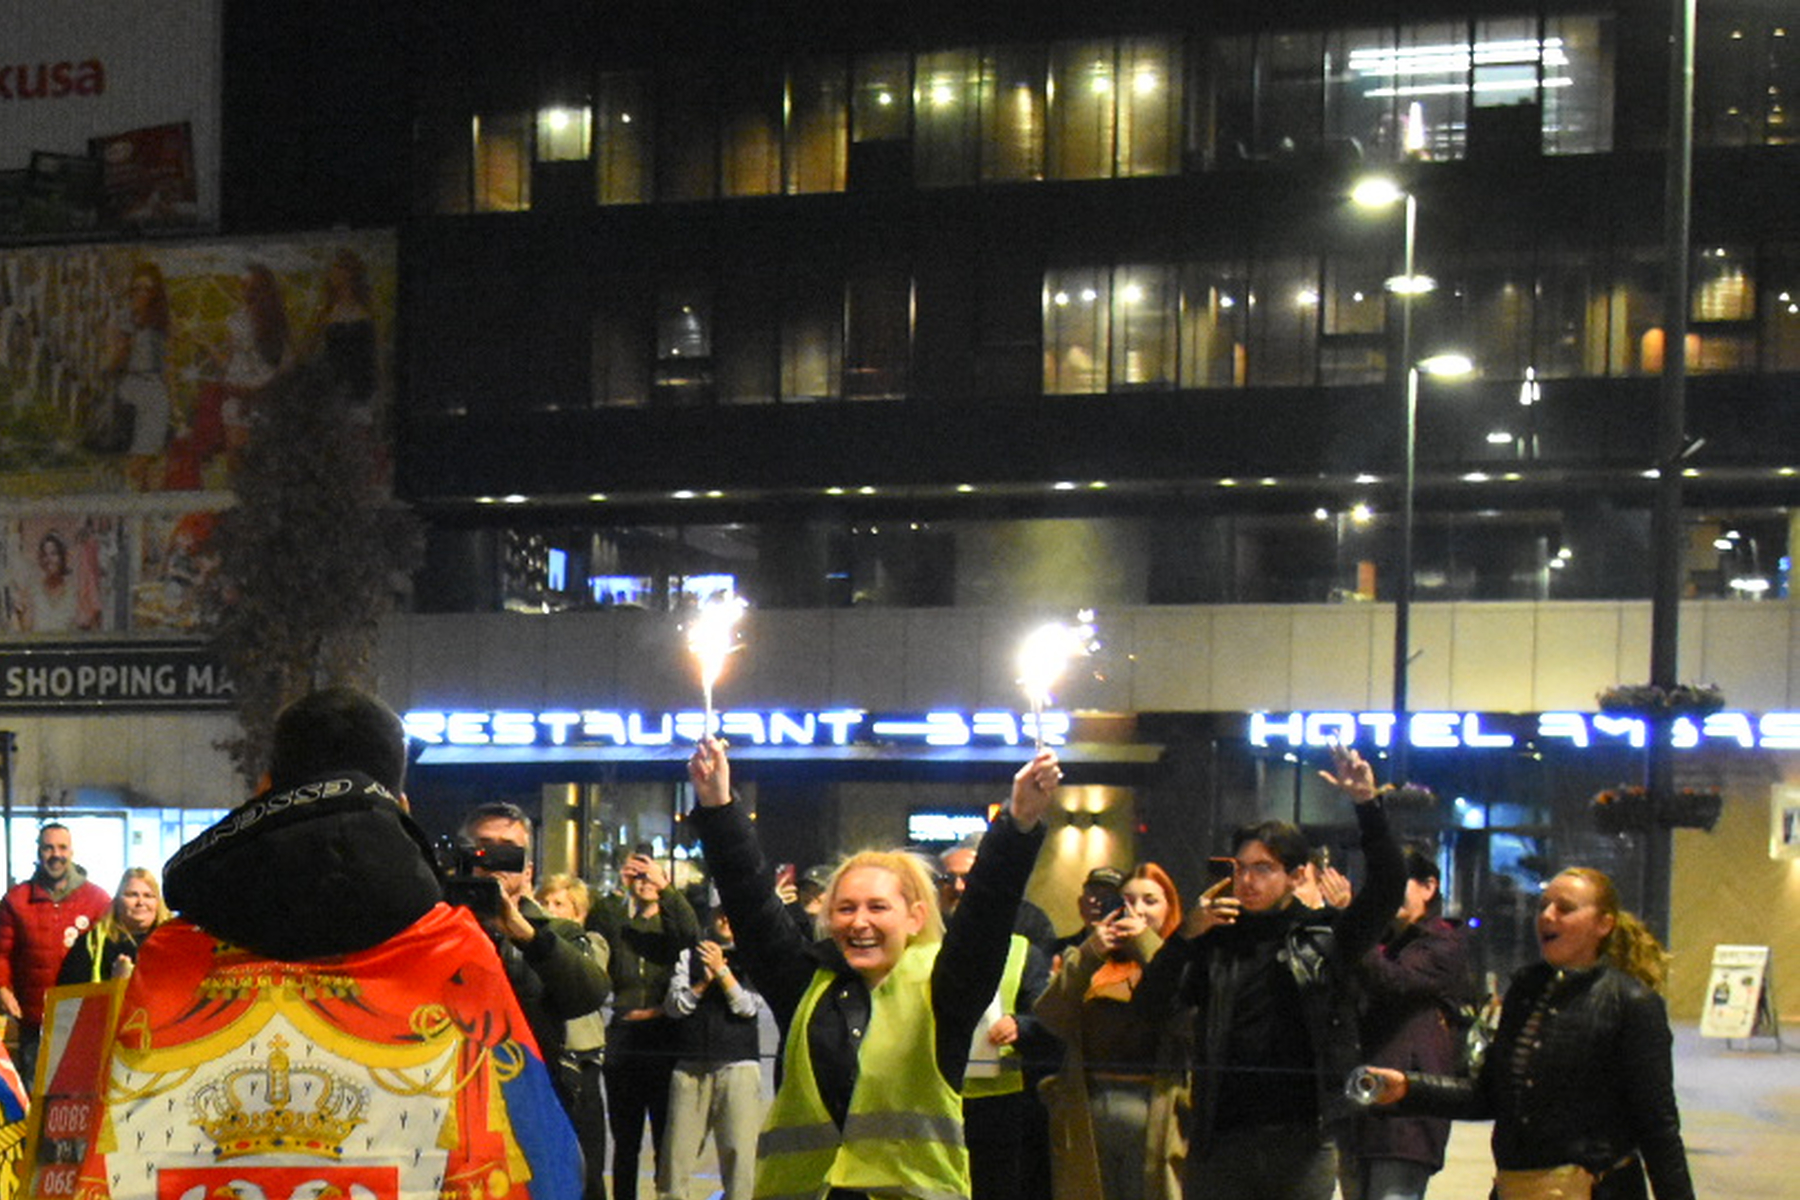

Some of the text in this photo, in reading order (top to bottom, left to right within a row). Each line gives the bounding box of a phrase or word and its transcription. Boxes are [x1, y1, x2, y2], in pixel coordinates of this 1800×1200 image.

[6, 666, 177, 697] SHOPPING
[403, 711, 863, 746] RESTAURANT
[1250, 711, 1514, 748] HOTEL
